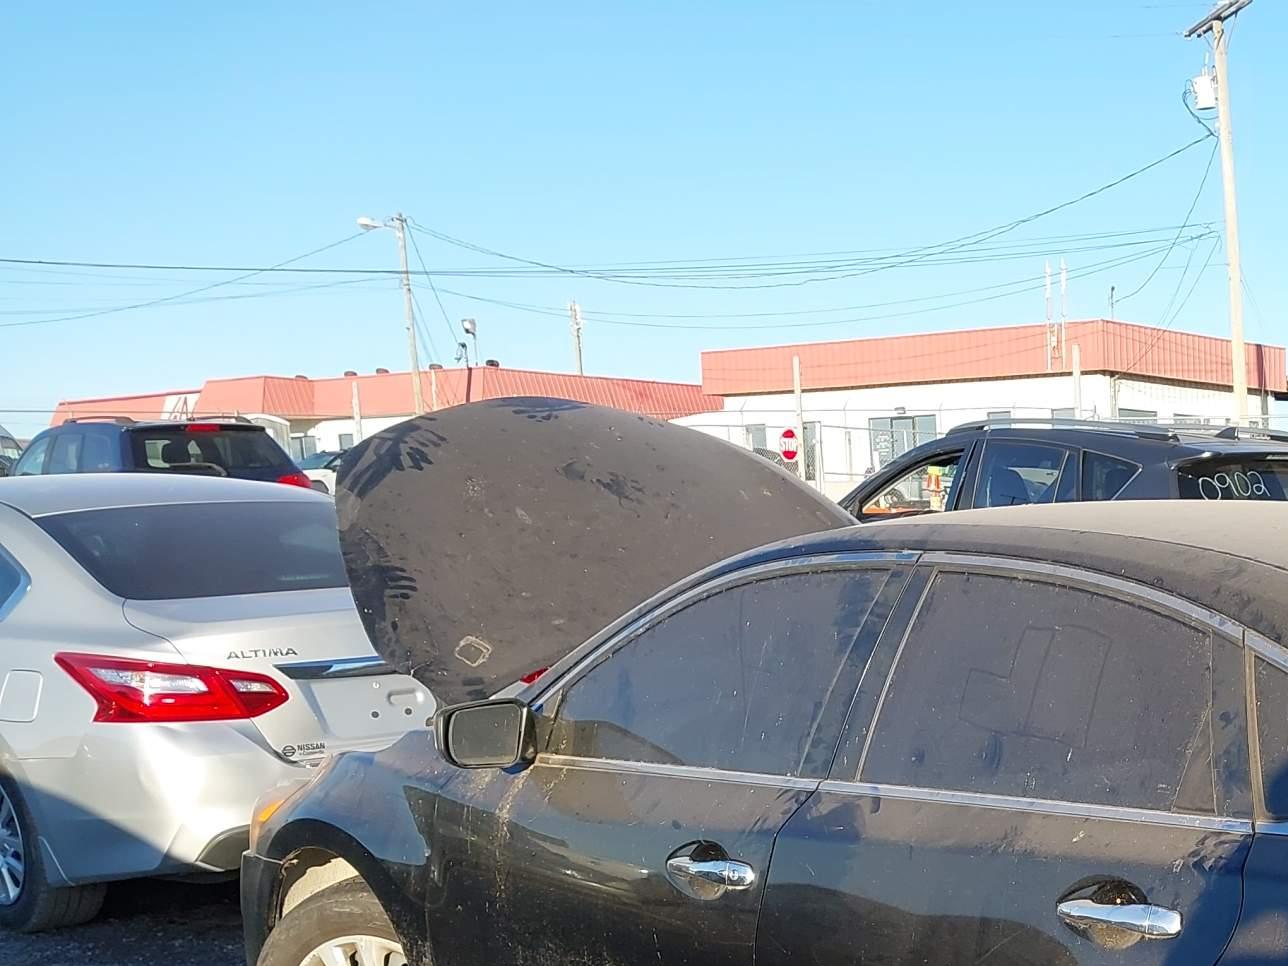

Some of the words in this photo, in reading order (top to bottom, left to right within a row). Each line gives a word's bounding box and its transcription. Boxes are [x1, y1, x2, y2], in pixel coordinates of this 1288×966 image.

[779, 437, 799, 452] STOP
[1199, 471, 1271, 500] 0902
[226, 647, 299, 660] ALTIMA
[297, 742, 326, 752] NISSAN
